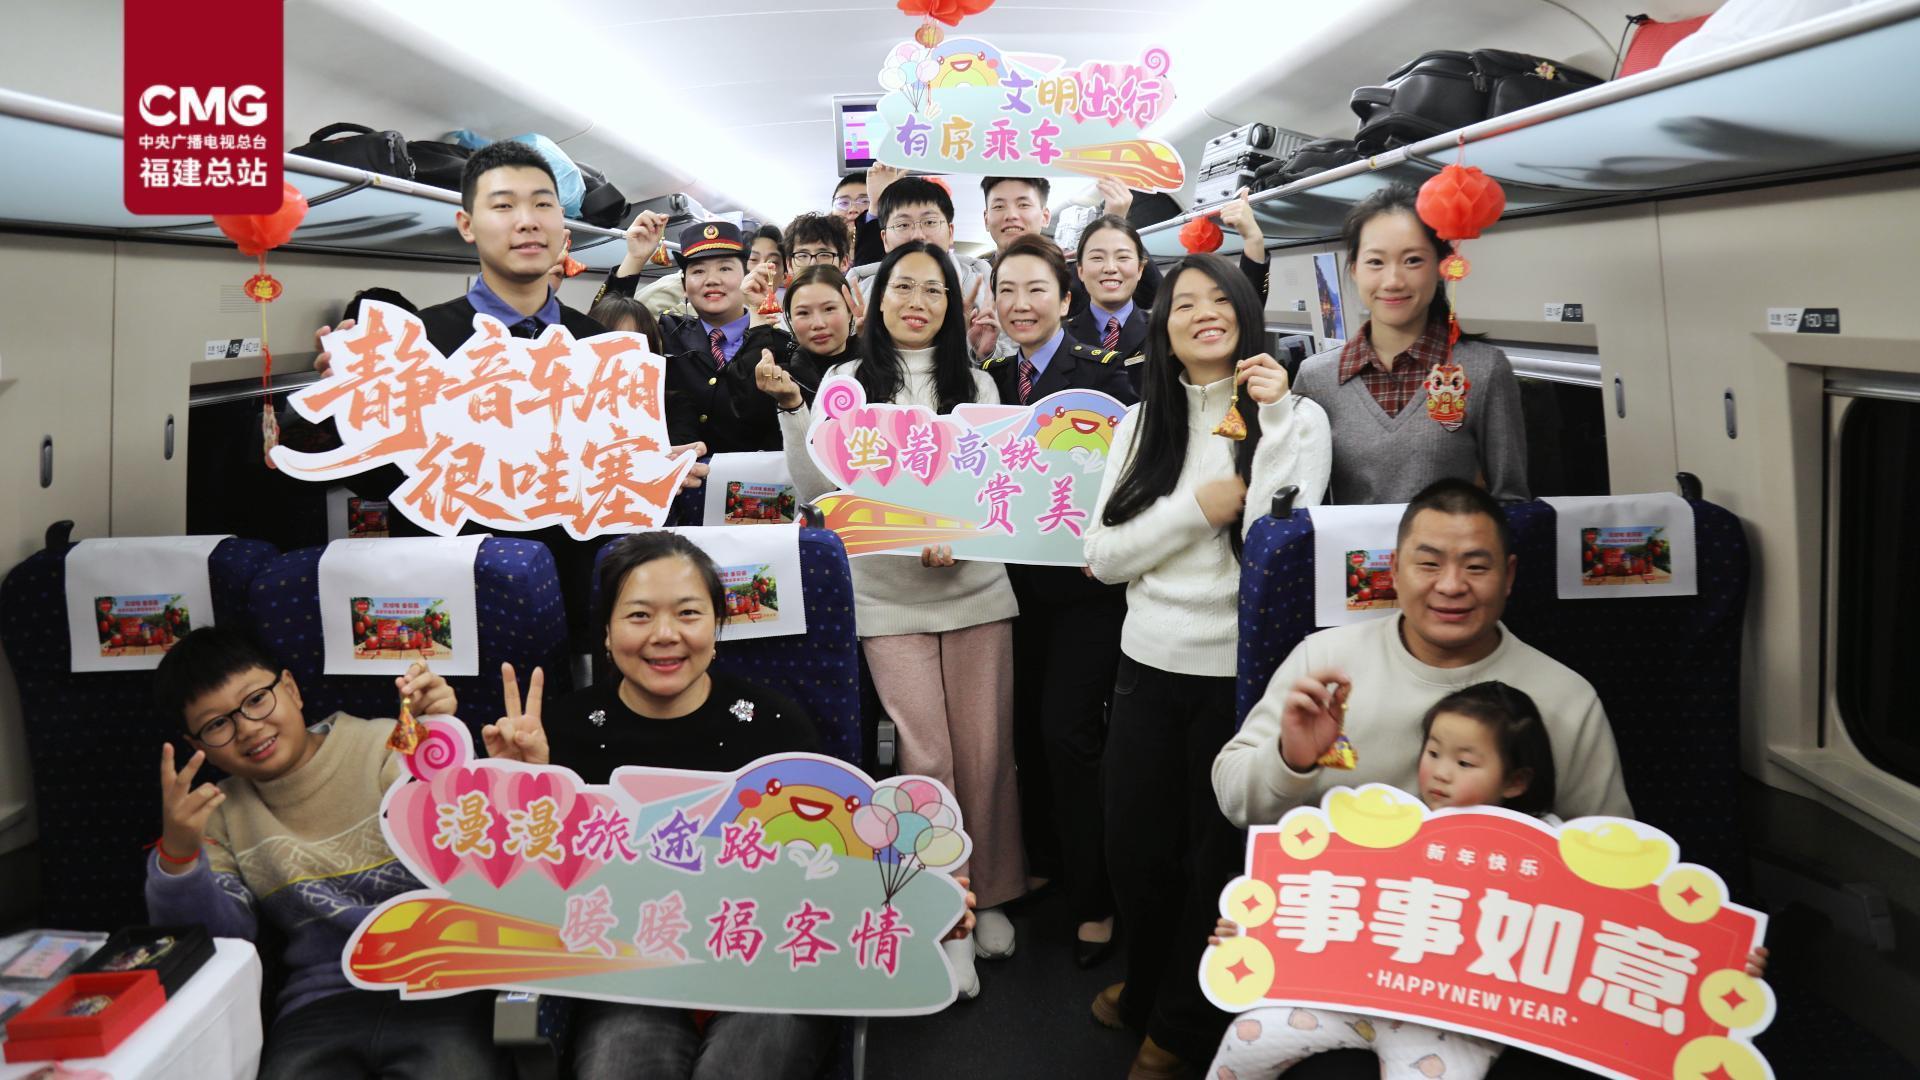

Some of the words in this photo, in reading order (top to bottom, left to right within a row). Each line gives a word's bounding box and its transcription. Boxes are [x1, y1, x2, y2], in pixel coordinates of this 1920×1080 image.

[1000, 70, 1161, 121] 文明出行
[896, 114, 1062, 165] 有序乘车
[292, 306, 662, 473] 静音车厢
[404, 424, 685, 536] 很哇塞
[847, 426, 1049, 477] 坐着高铁
[434, 795, 780, 873] 漫漫旅途路
[1426, 843, 1540, 877] 新年快乐
[560, 888, 915, 975] 暖暖福客情
[1272, 870, 1701, 1036] 事事如意
[1508, 996, 1568, 1027] YEAR
